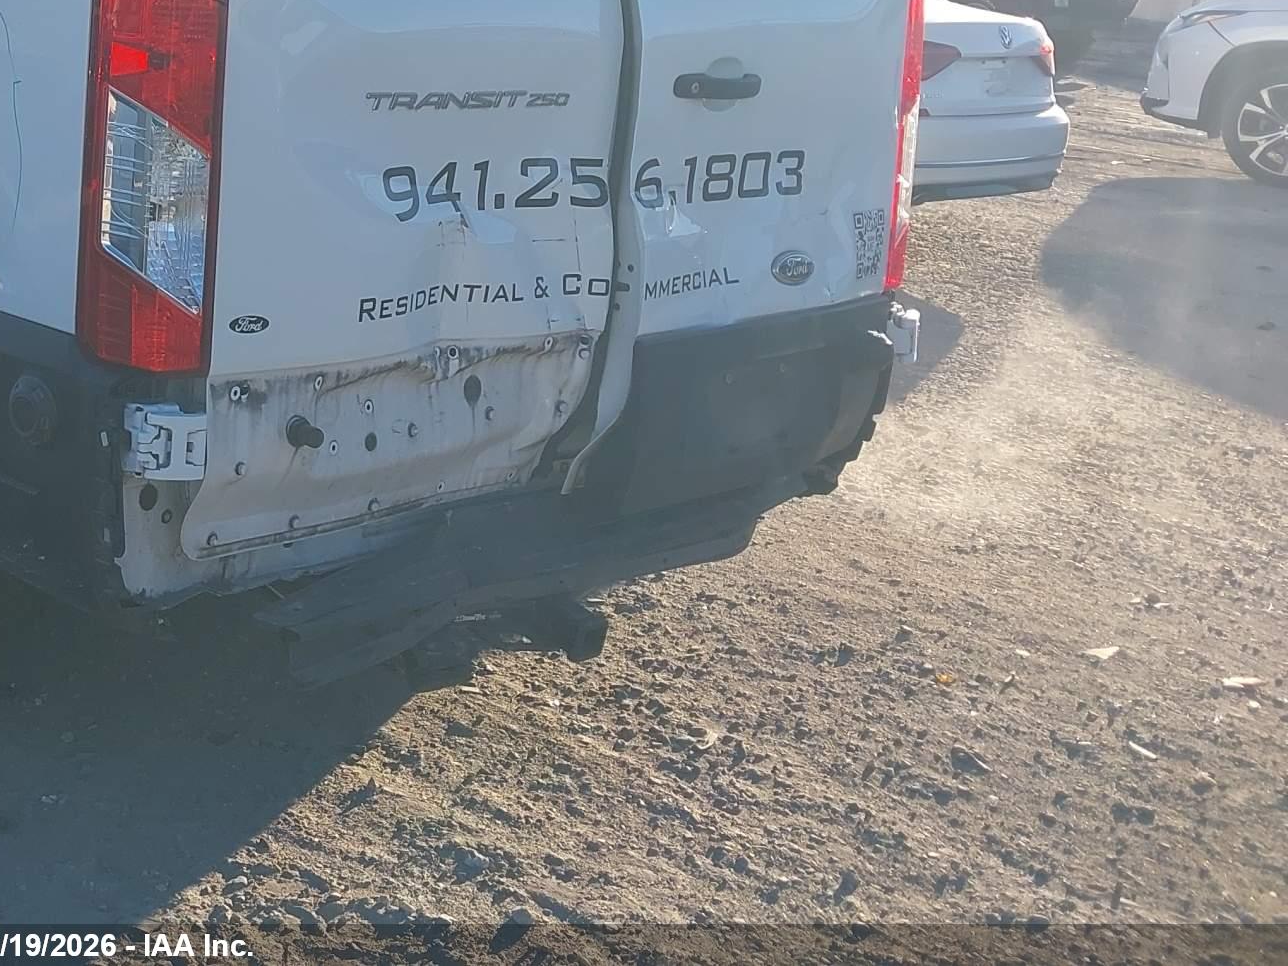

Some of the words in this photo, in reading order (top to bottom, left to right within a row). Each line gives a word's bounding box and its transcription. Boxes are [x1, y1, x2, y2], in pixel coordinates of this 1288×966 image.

[366, 90, 528, 111] TRANSIT
[526, 92, 571, 107] 250
[358, 283, 524, 323] RESIDENTIAL
[534, 276, 550, 299] &
[232, 316, 265, 332] Ford
